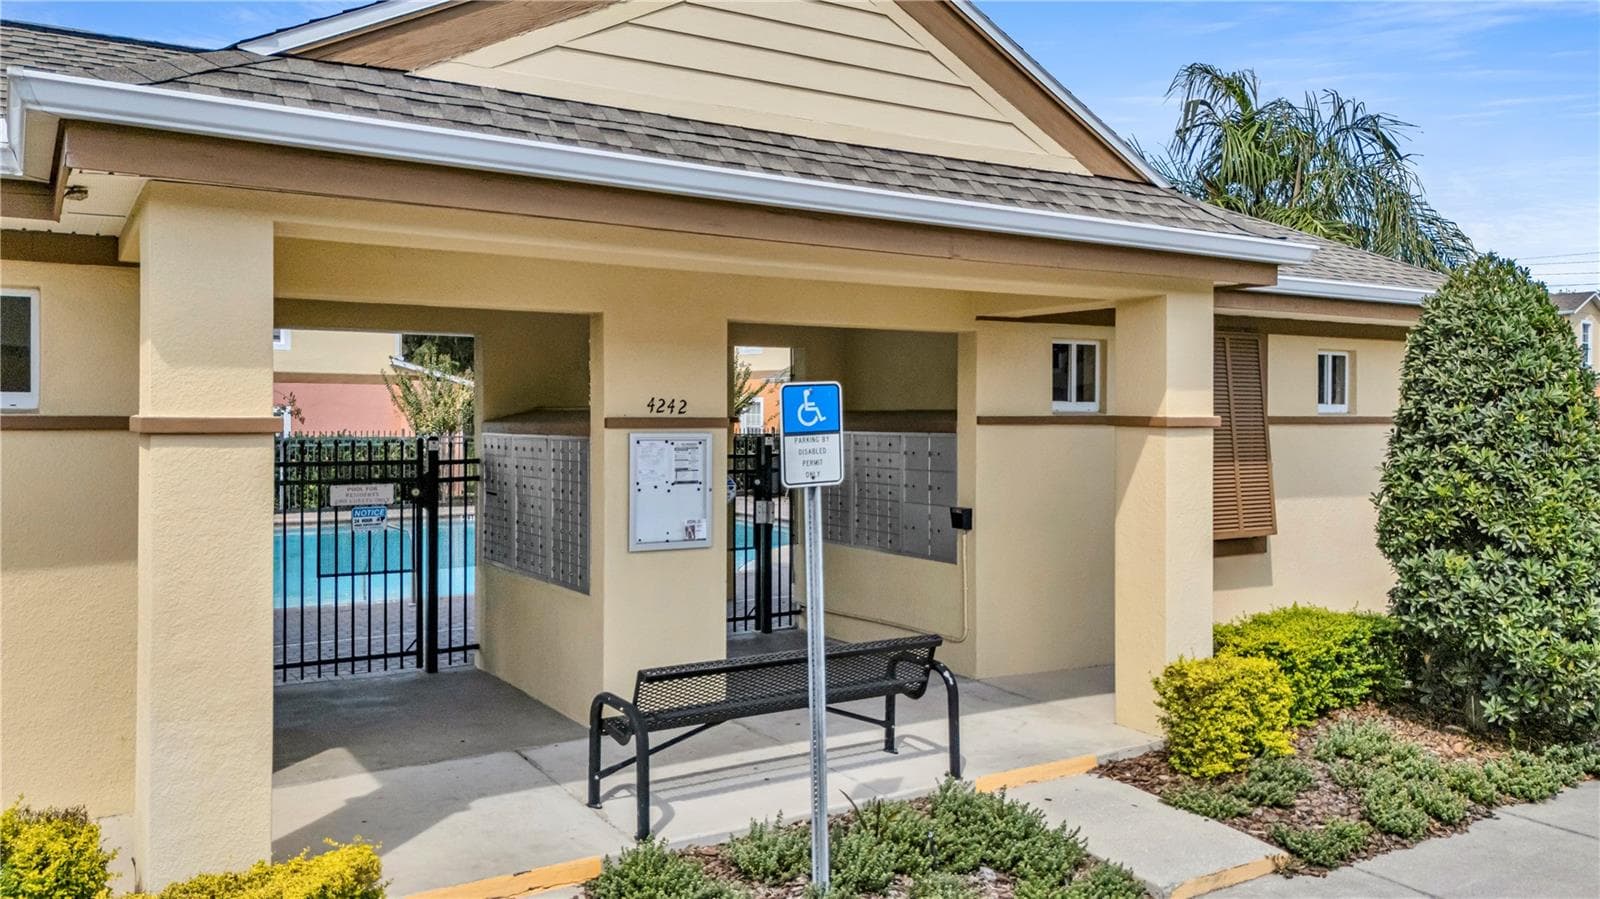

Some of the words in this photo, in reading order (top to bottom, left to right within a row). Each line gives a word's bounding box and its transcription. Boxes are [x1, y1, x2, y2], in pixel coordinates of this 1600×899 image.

[647, 397, 687, 414] 4242
[794, 436, 820, 444] PARKING
[798, 447, 827, 456] DISABLED
[802, 459, 823, 467] PERMIT
[354, 508, 386, 517] NOTICE
